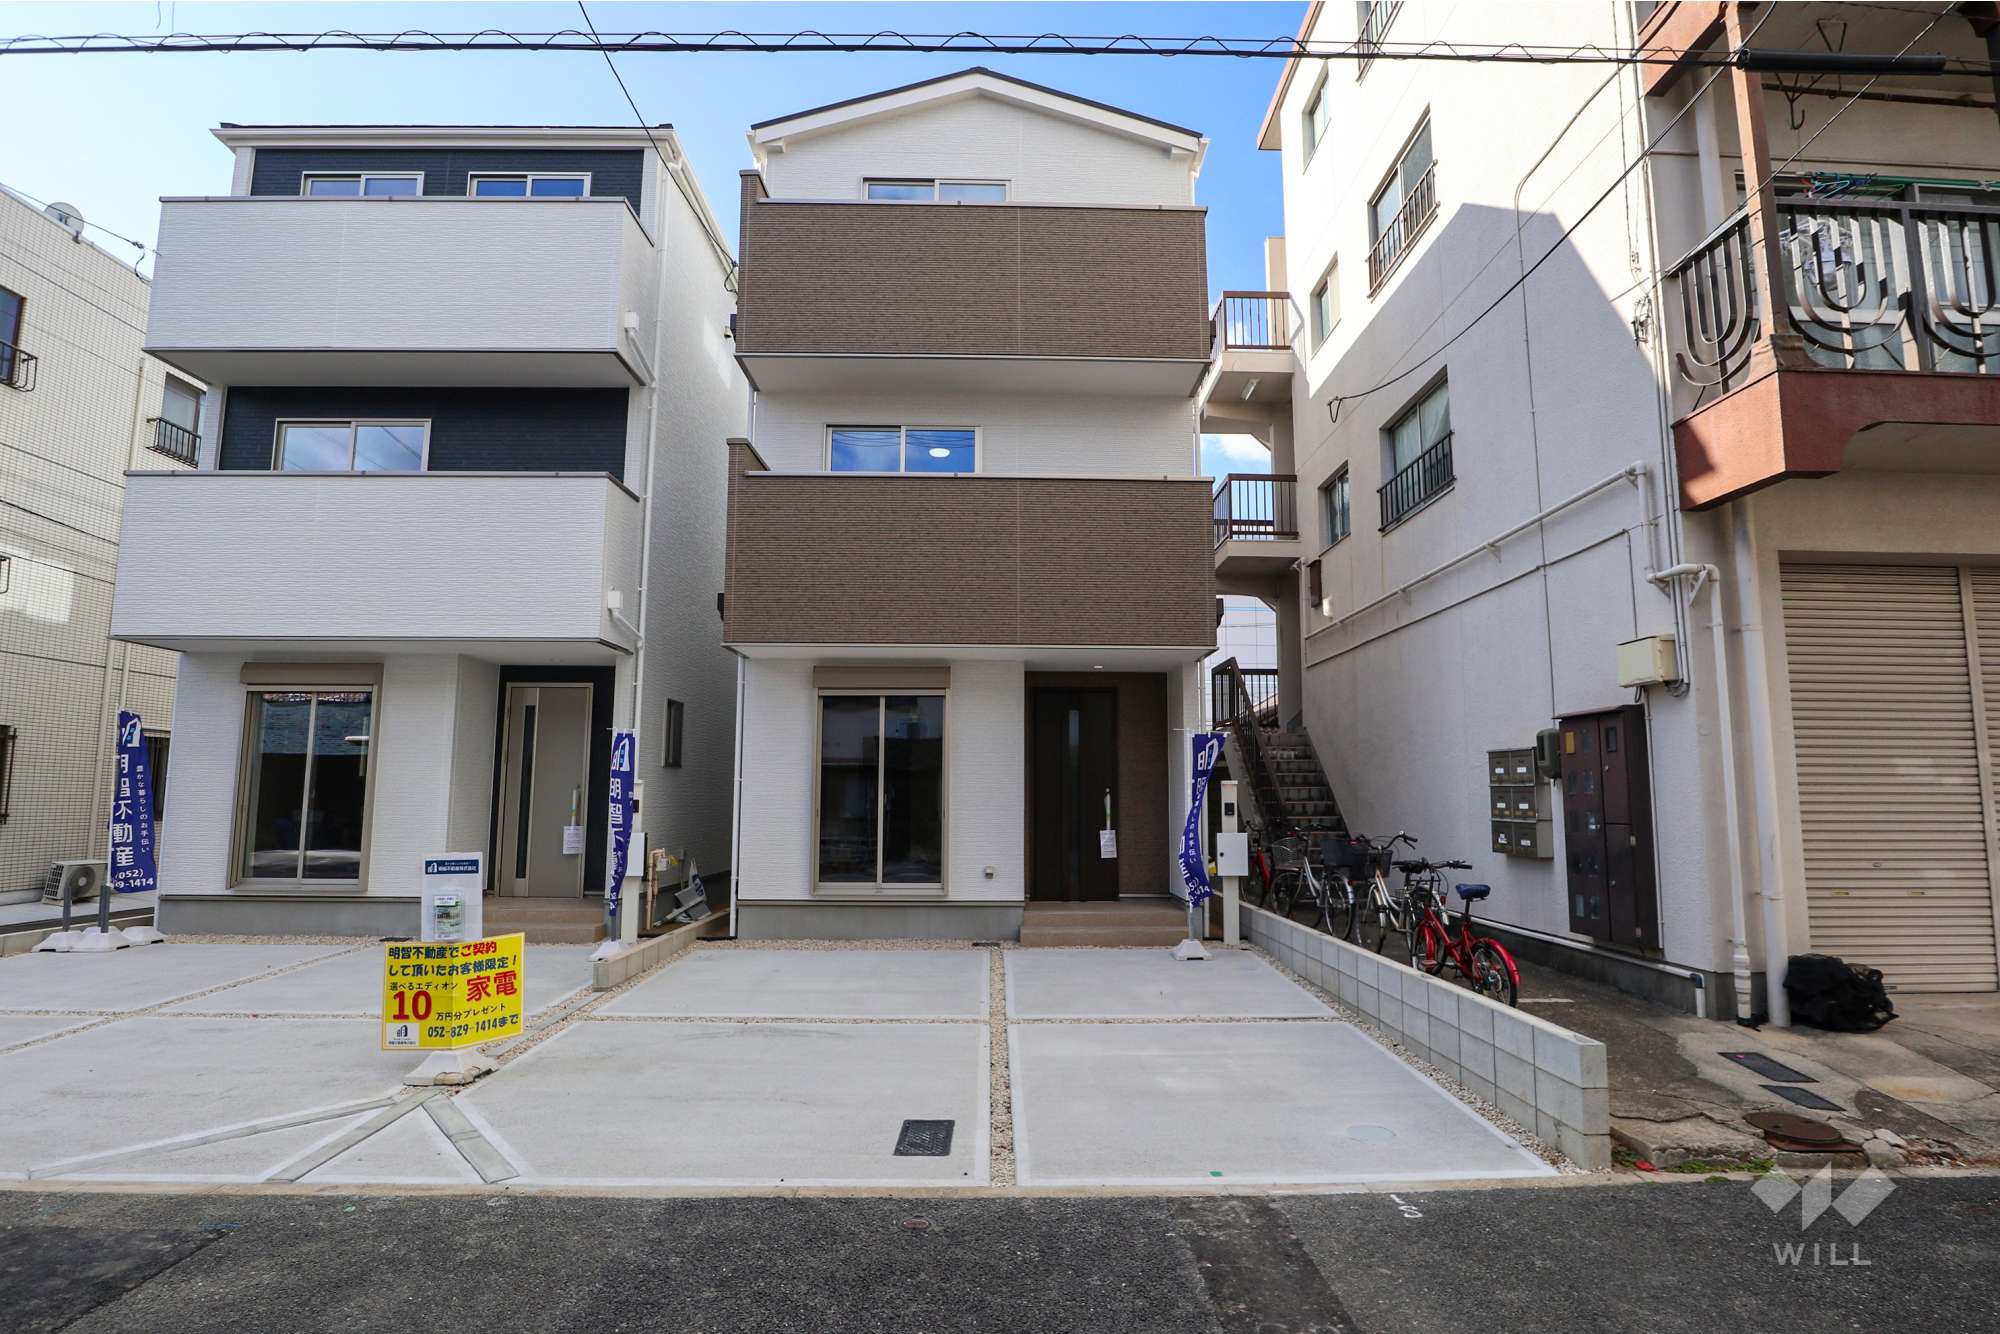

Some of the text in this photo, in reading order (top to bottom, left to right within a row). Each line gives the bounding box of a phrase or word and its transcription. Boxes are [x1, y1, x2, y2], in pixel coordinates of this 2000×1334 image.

[388, 941, 497, 960] 明智不動産でご契約
[390, 981, 458, 991] 選べるエディオン
[466, 970, 518, 1002] 家電
[392, 990, 433, 1021] 10
[436, 1002, 506, 1022] 万円分プレゼント
